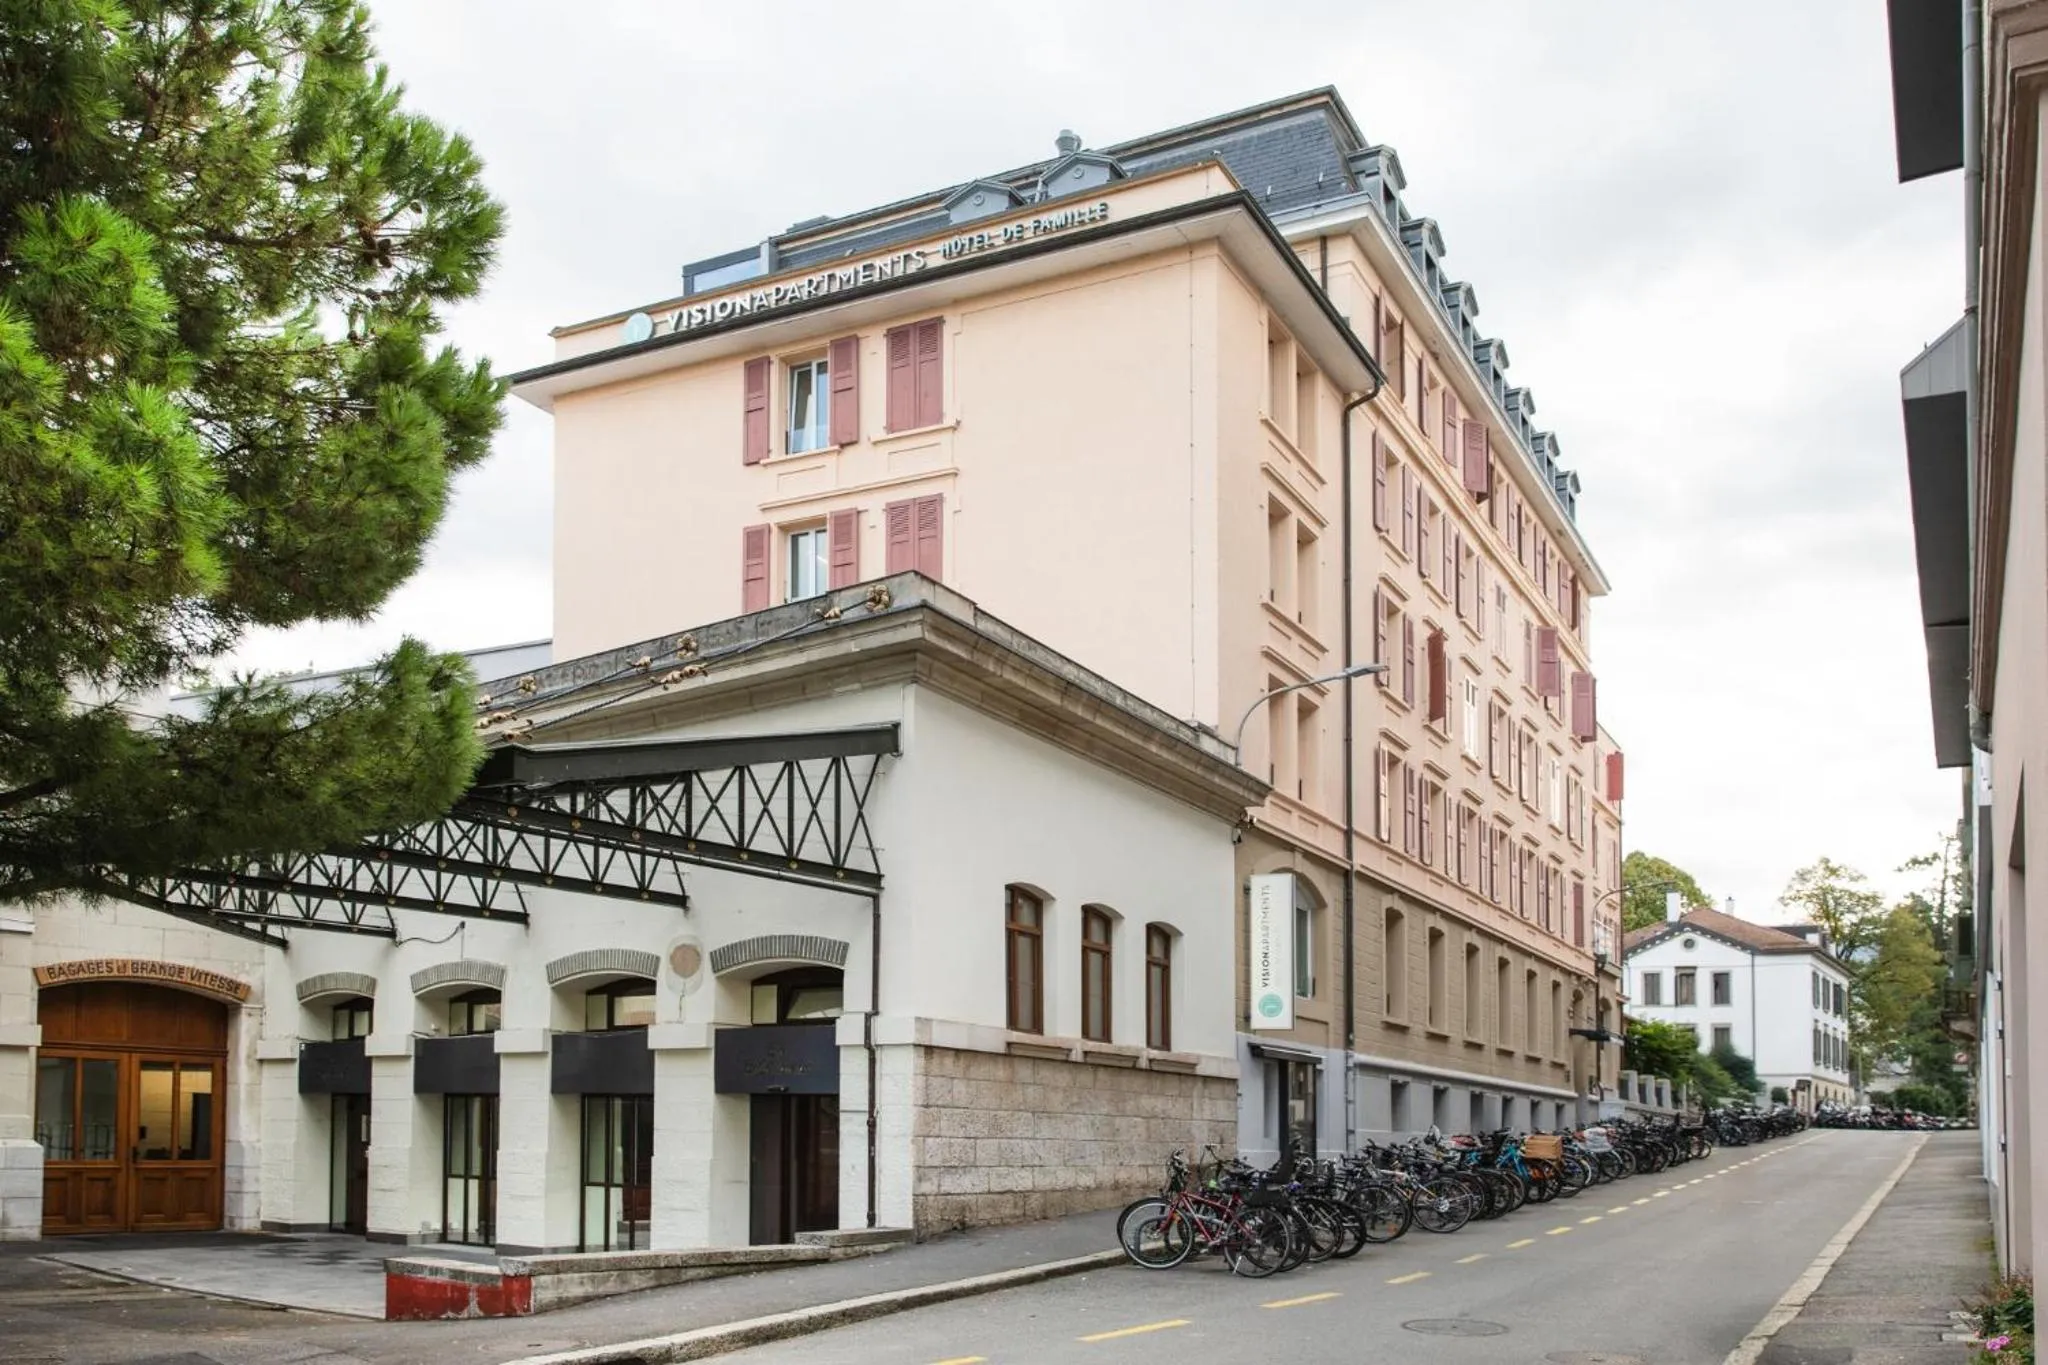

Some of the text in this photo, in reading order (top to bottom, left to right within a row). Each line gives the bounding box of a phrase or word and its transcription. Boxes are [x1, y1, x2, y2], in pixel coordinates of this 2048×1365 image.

[667, 250, 927, 331] VISIONAPARTMENTS
[1001, 223, 1025, 243] DE
[1031, 202, 1109, 236] FAMILLE
[47, 960, 114, 980] BAGAGES
[131, 960, 186, 980] GRANDE
[189, 968, 242, 996] VITESSE
